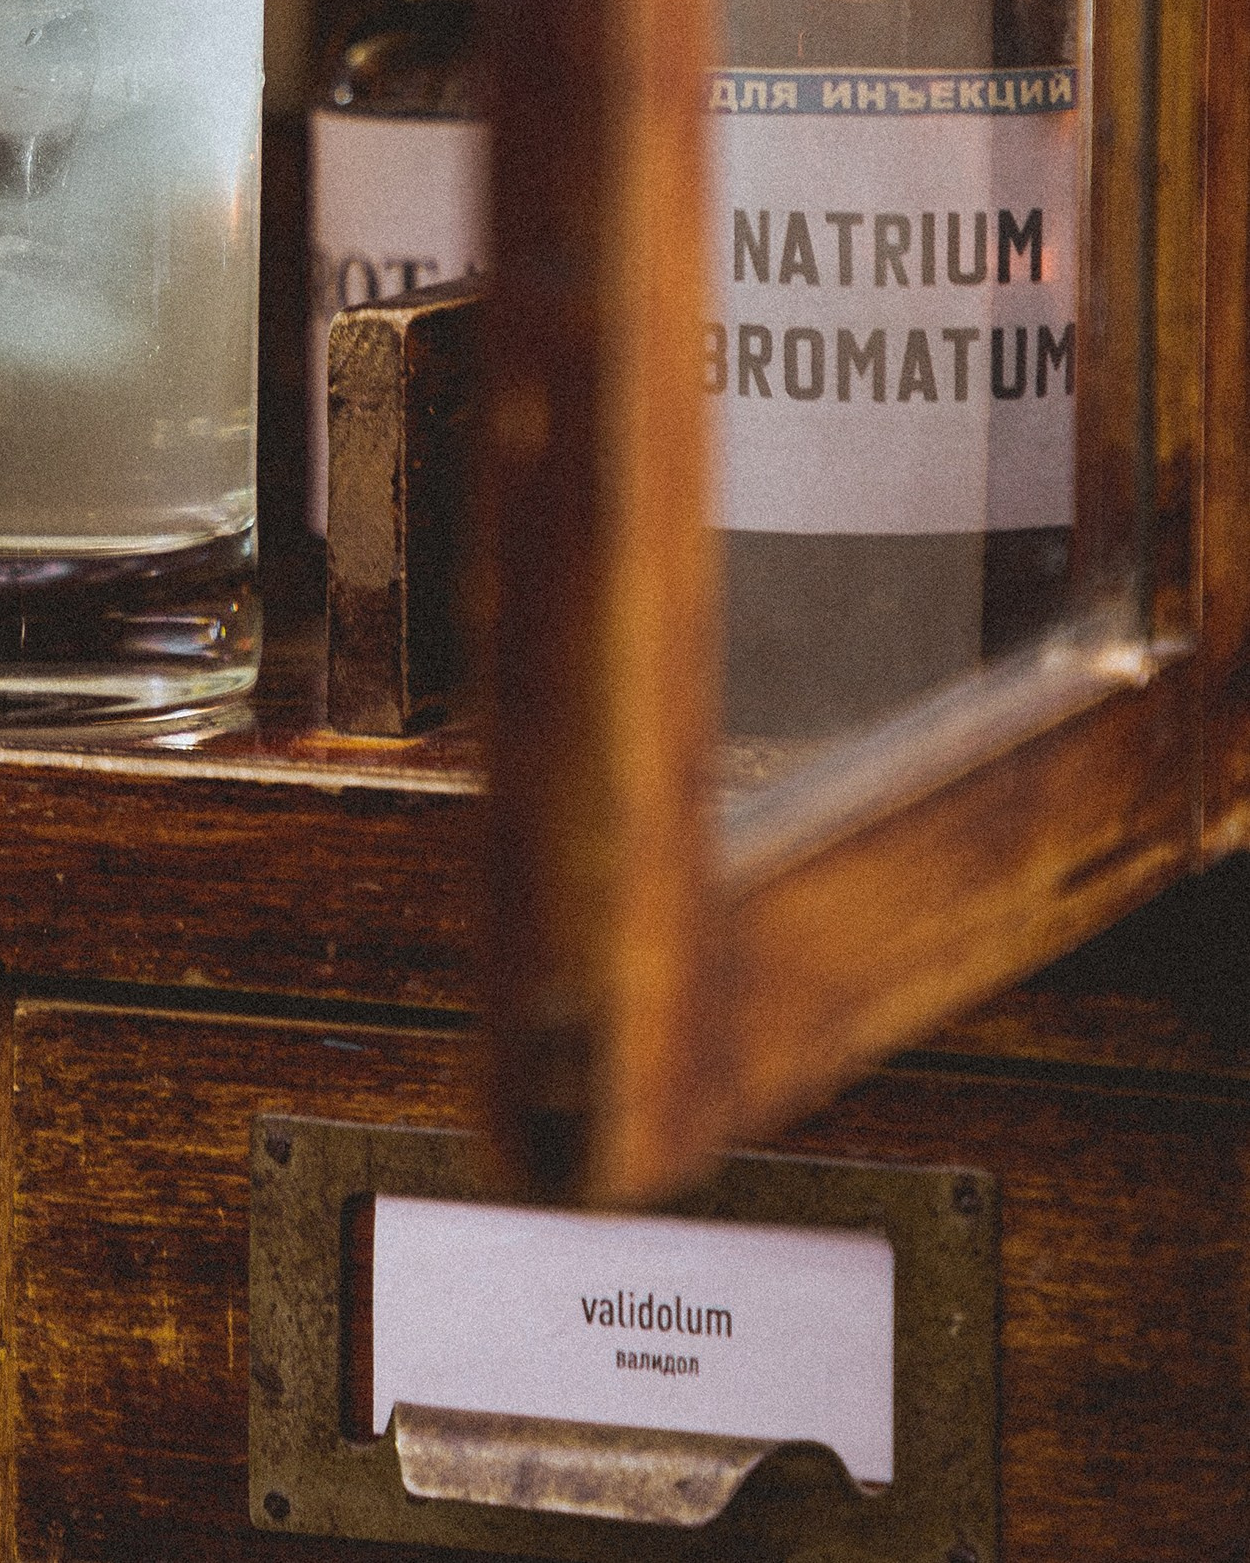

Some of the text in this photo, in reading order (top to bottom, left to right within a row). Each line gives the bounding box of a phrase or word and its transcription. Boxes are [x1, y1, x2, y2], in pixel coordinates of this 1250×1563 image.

[709, 72, 1074, 112] ДЛЯ ИНЪЕКЦИЙ
[733, 207, 1044, 288] NATRIUM
[702, 321, 1077, 404] BROMATUM
[580, 1290, 733, 1338] validolum
[615, 1349, 700, 1377] валидол
